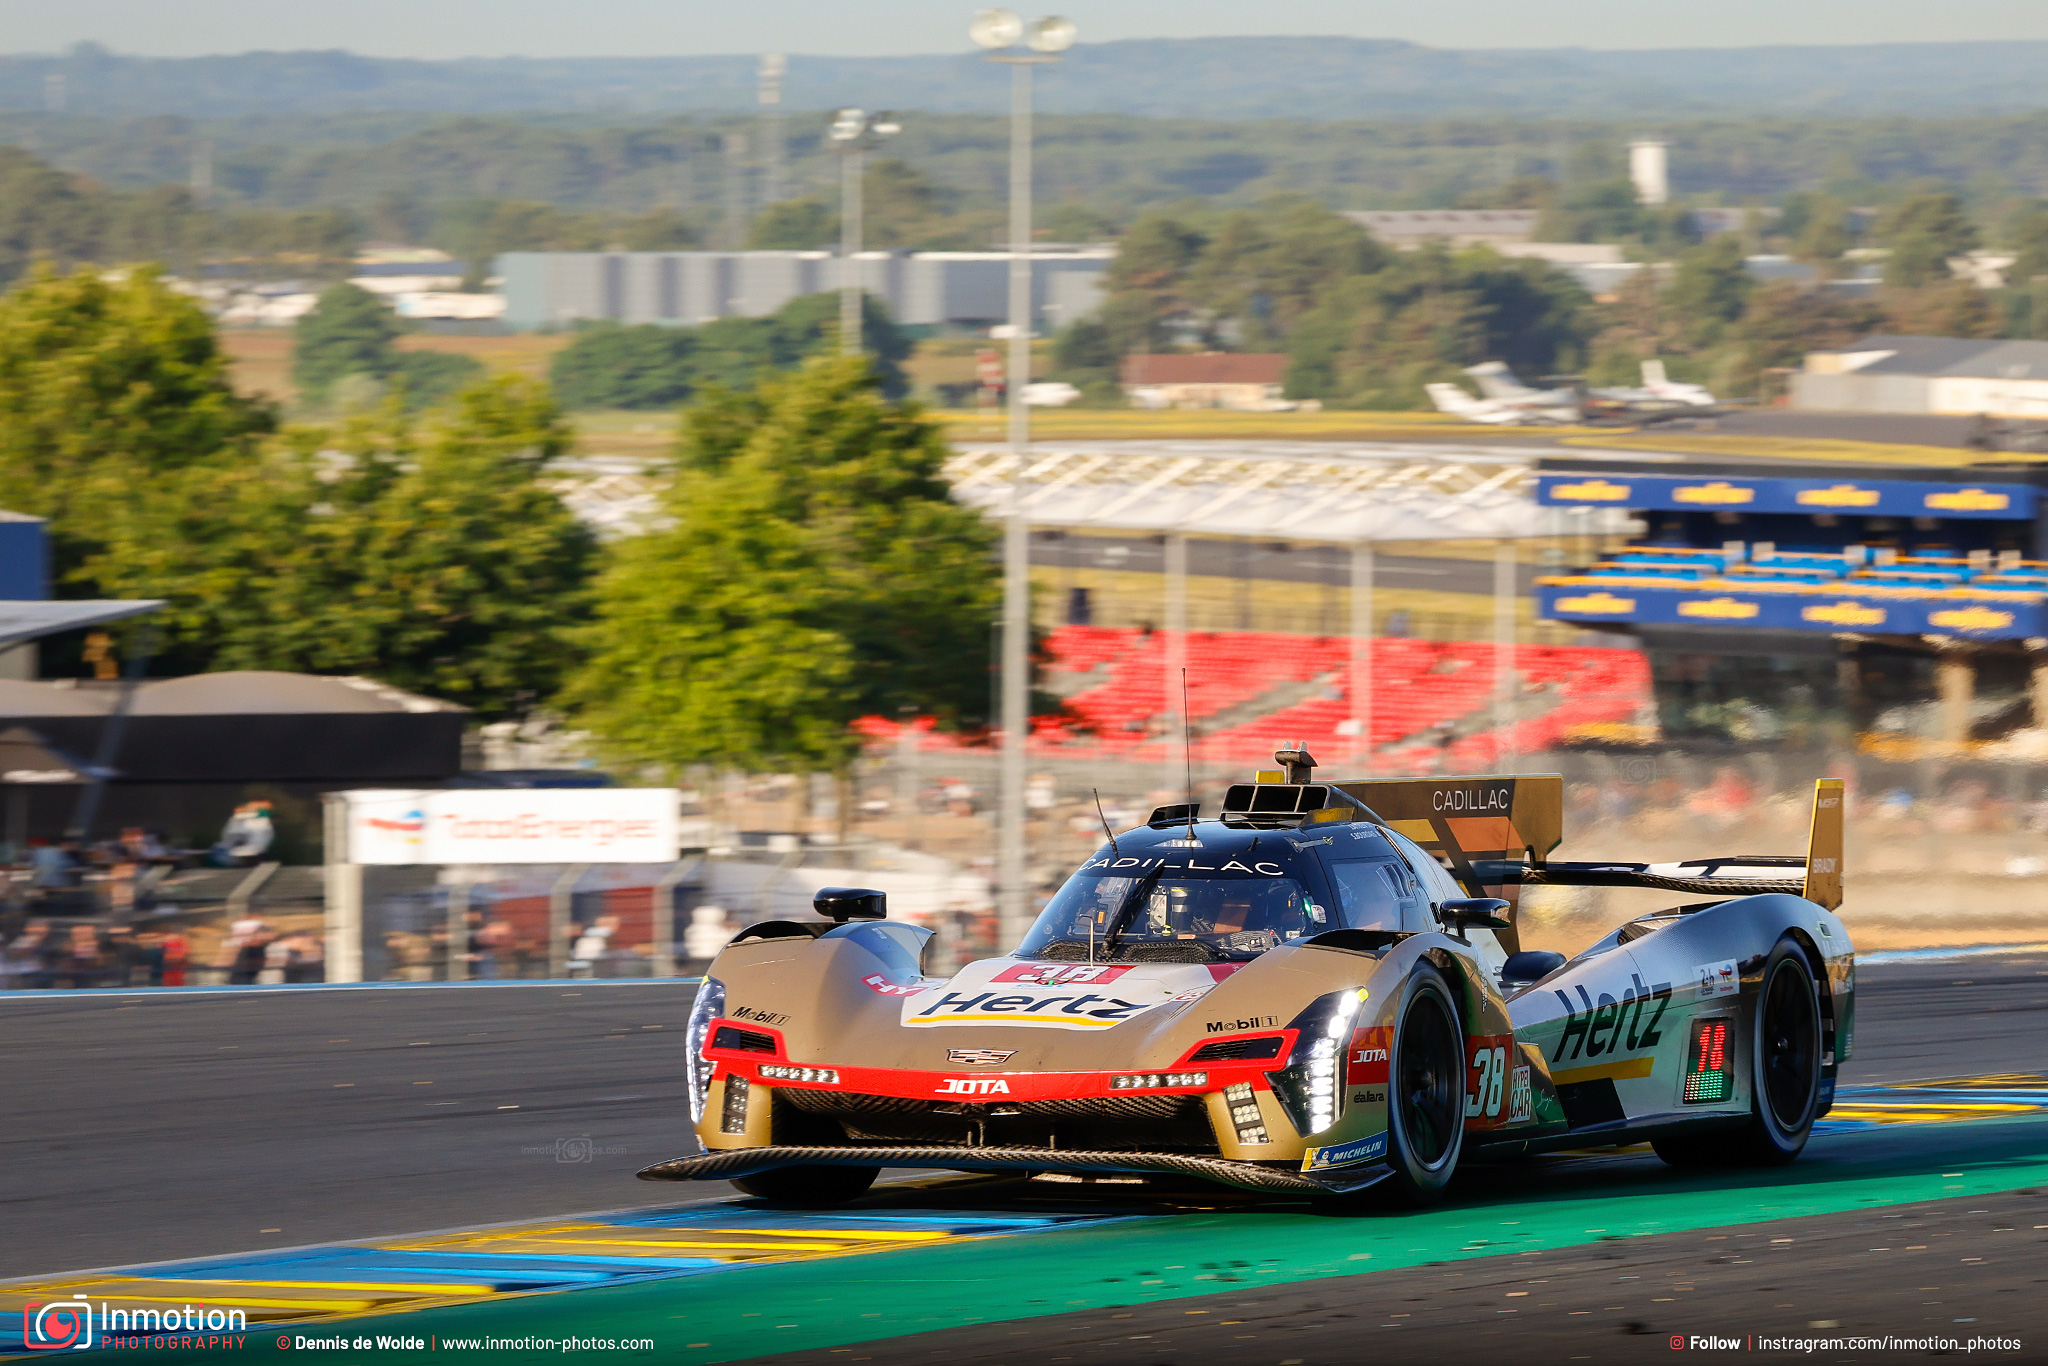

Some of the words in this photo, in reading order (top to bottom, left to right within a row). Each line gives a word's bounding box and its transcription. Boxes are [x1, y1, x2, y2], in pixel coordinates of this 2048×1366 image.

[1432, 789, 1509, 811] CADILLAC
[1079, 857, 1284, 876] CADILLAC
[1016, 964, 1113, 982] 38
[731, 1006, 778, 1024] Mobil
[918, 992, 1151, 1019] Hertz
[1206, 1017, 1260, 1033] Mobil
[1552, 973, 1672, 1063] Hertz
[1352, 1048, 1388, 1063] JOTA
[934, 1078, 1010, 1094] JOTA
[1465, 1045, 1506, 1118] 38
[1509, 1089, 1532, 1118] CAR
[1331, 1140, 1383, 1162] MICHELIN
